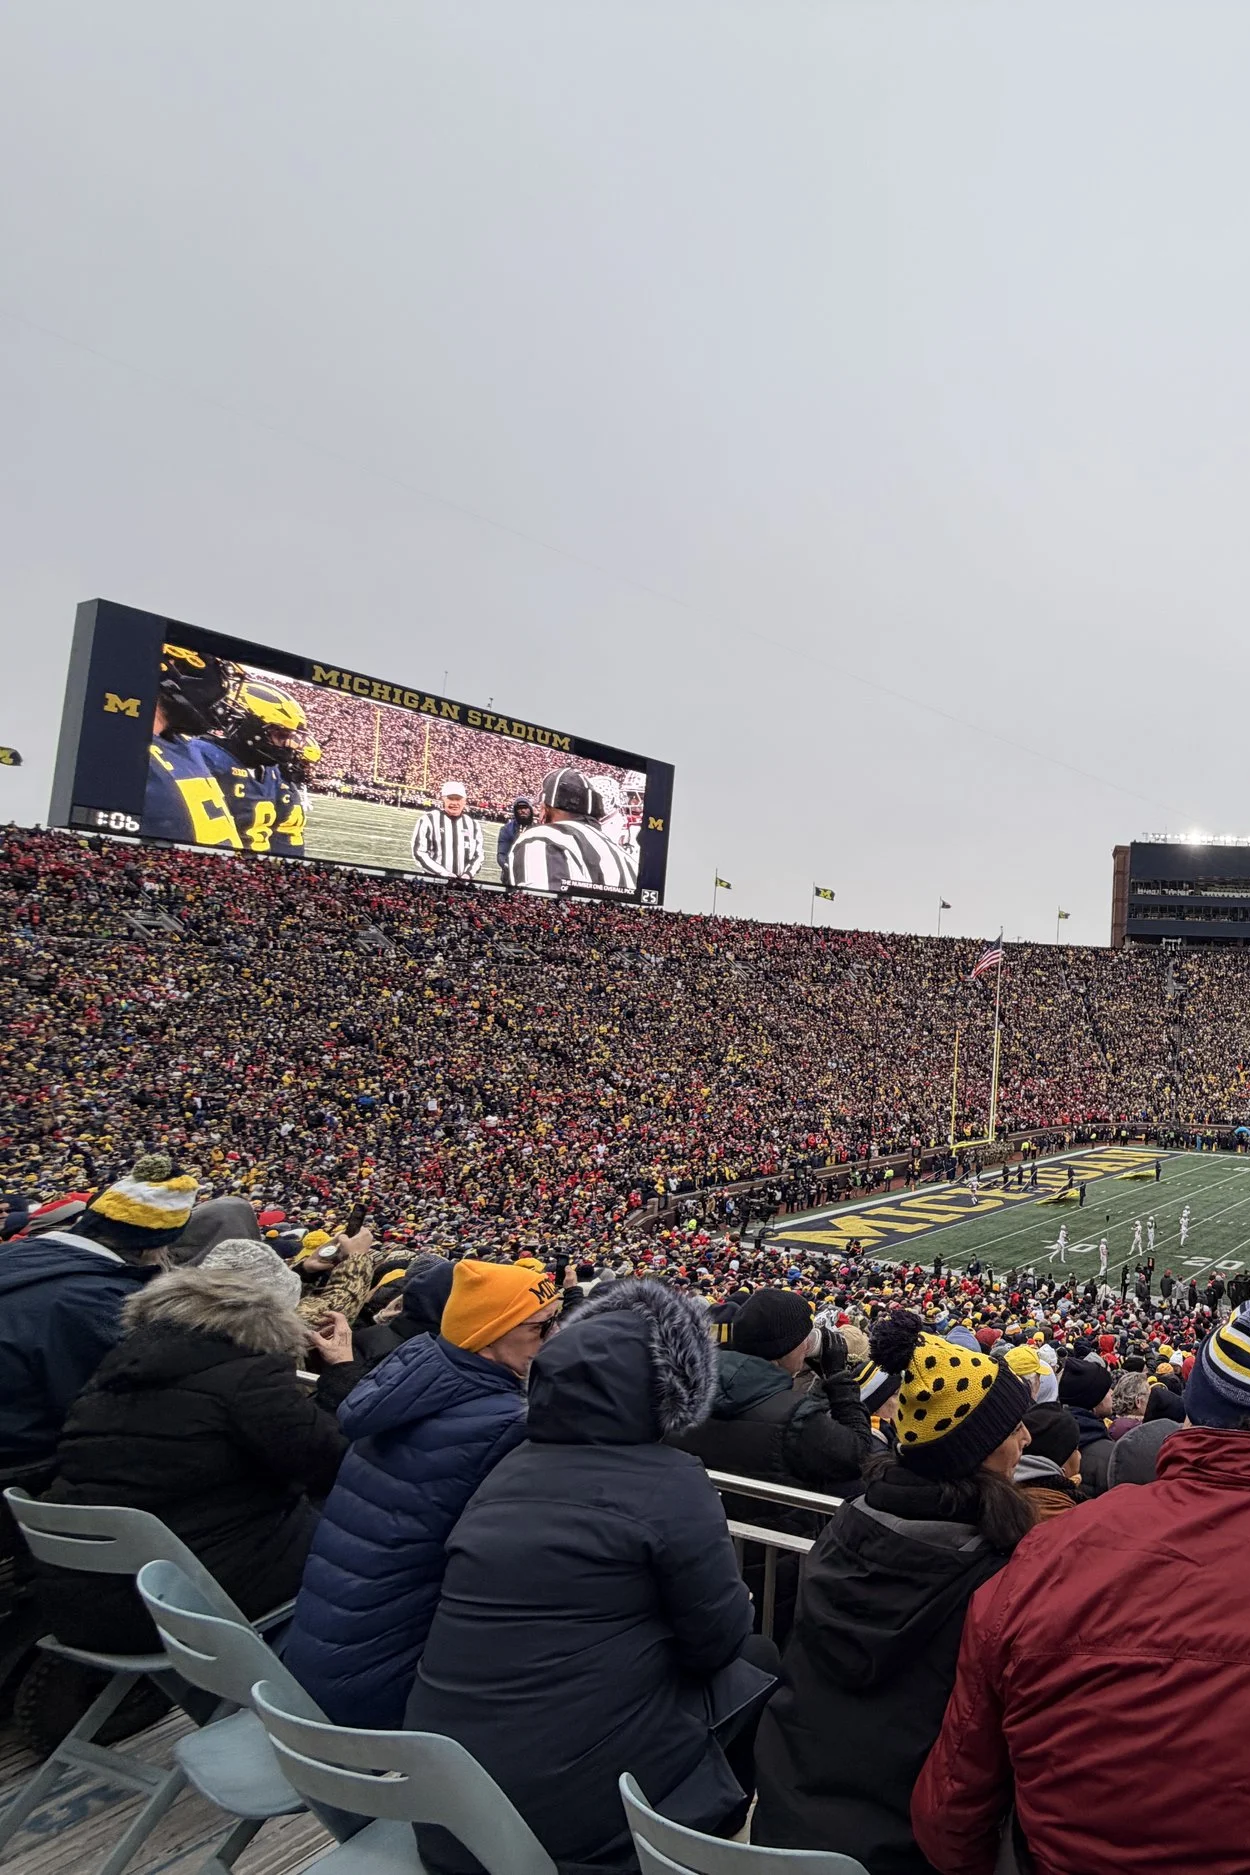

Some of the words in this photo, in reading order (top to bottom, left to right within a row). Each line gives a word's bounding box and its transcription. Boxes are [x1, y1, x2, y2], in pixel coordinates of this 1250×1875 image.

[103, 692, 141, 718] M
[312, 664, 461, 720] MICHIGAN
[467, 710, 572, 751] STADIUM
[648, 816, 664, 832] M
[642, 890, 657, 903] 25
[1183, 1256, 1245, 1270] 20
